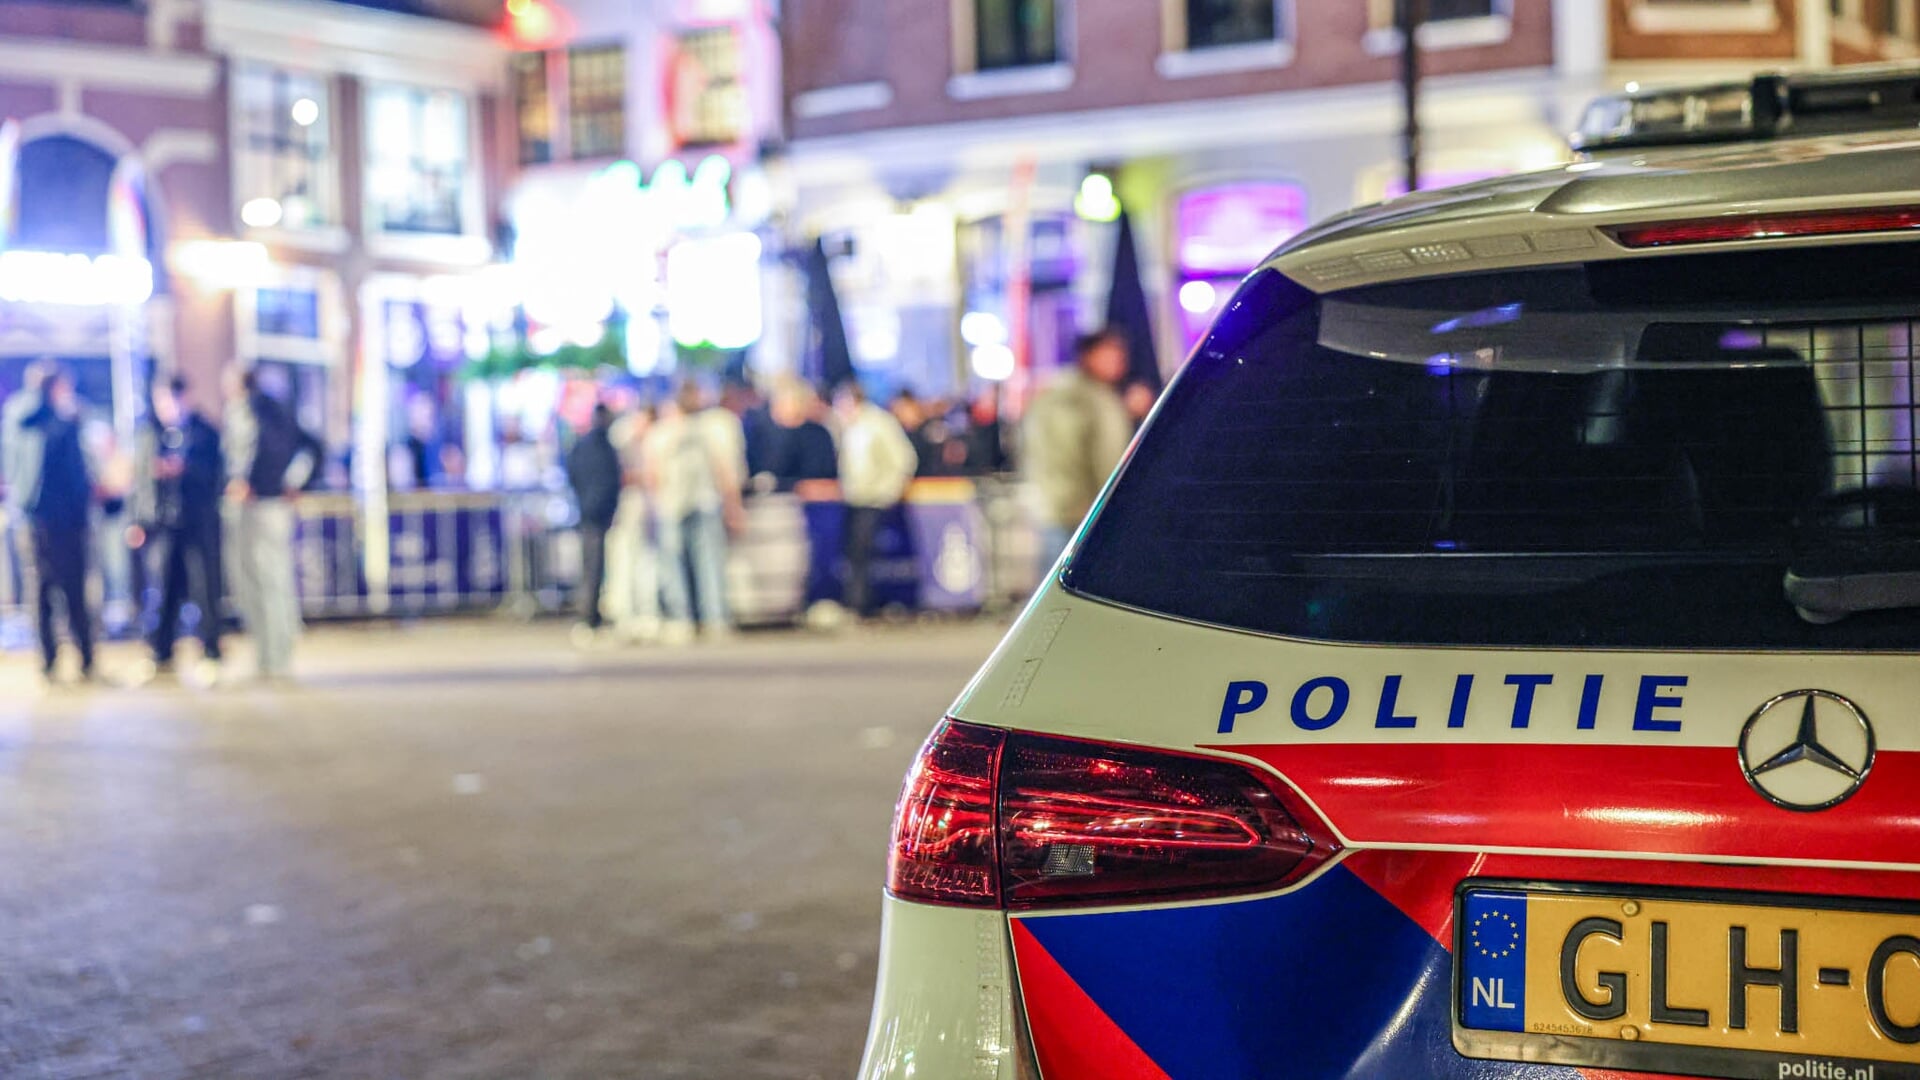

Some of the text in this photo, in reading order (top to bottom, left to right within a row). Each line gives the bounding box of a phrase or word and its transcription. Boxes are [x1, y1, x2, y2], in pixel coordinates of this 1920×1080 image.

[1217, 674, 1689, 733] POLITIE
[1471, 977, 1516, 1009] NL
[1778, 1059, 1874, 1080] politie.nl
